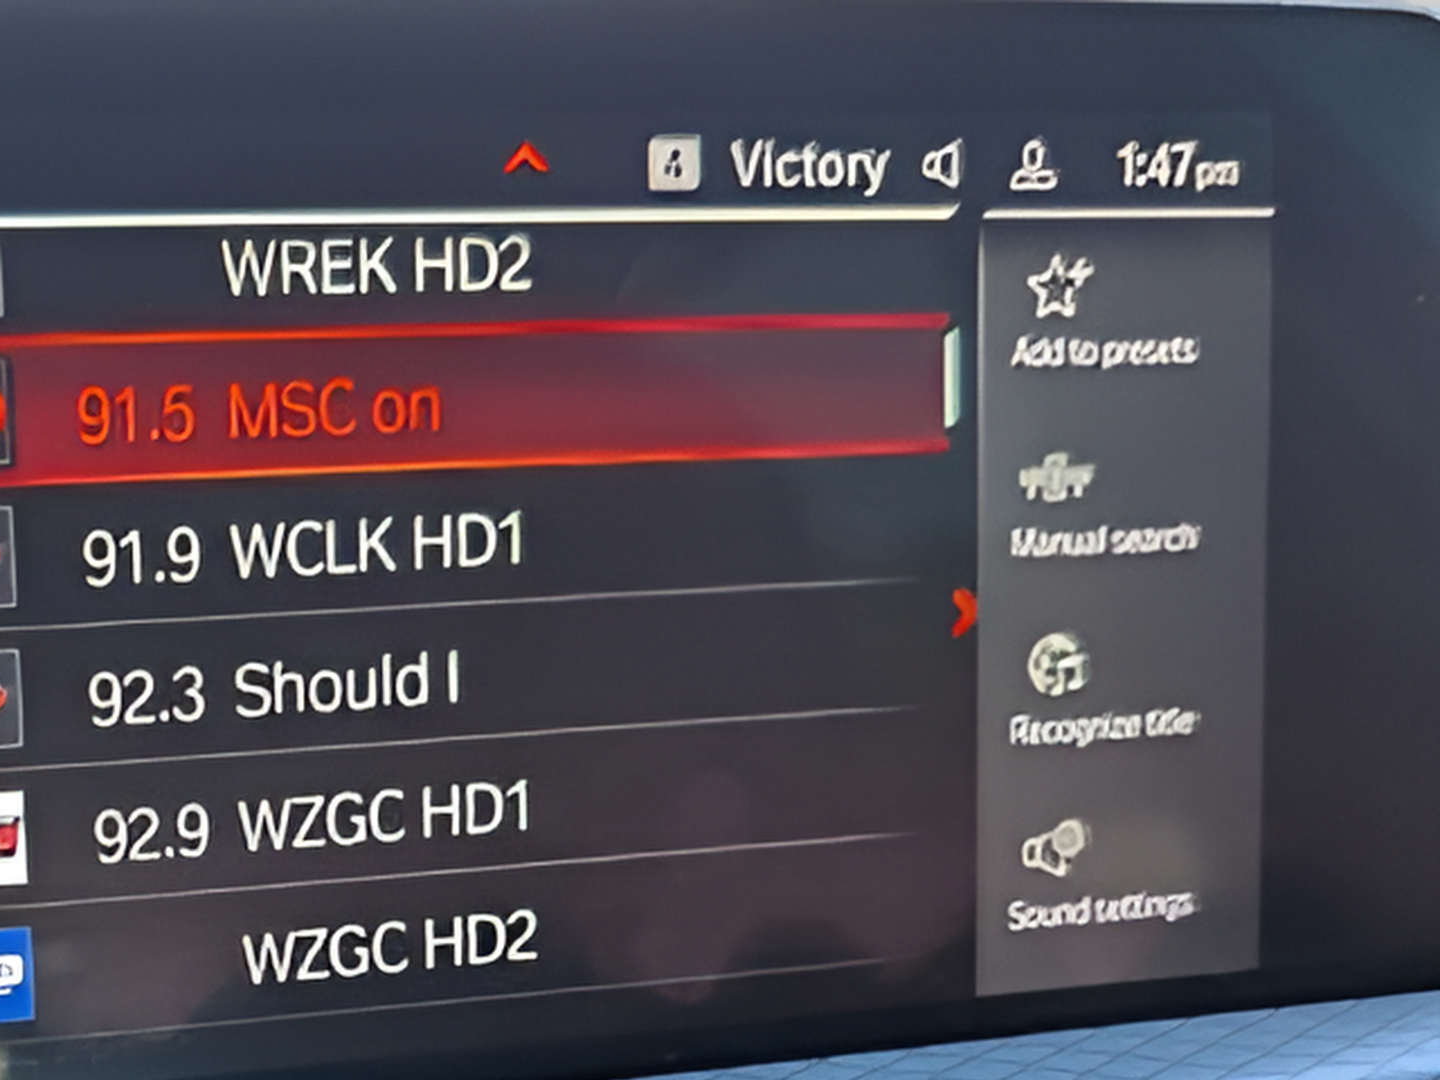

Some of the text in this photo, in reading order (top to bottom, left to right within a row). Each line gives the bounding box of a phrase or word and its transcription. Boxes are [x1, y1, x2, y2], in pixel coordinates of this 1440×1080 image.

[730, 139, 891, 197] Victory
[221, 234, 533, 298] WREK HD2
[77, 376, 442, 445] 91.5 MSC on
[83, 510, 524, 588] 91.9 WCLK HD1
[88, 665, 206, 728] 92.3
[234, 652, 430, 720] Should
[93, 802, 211, 865] 92.9
[238, 788, 405, 852] WZGC
[422, 779, 531, 840] HD1
[243, 909, 539, 985] WZGC HD2
